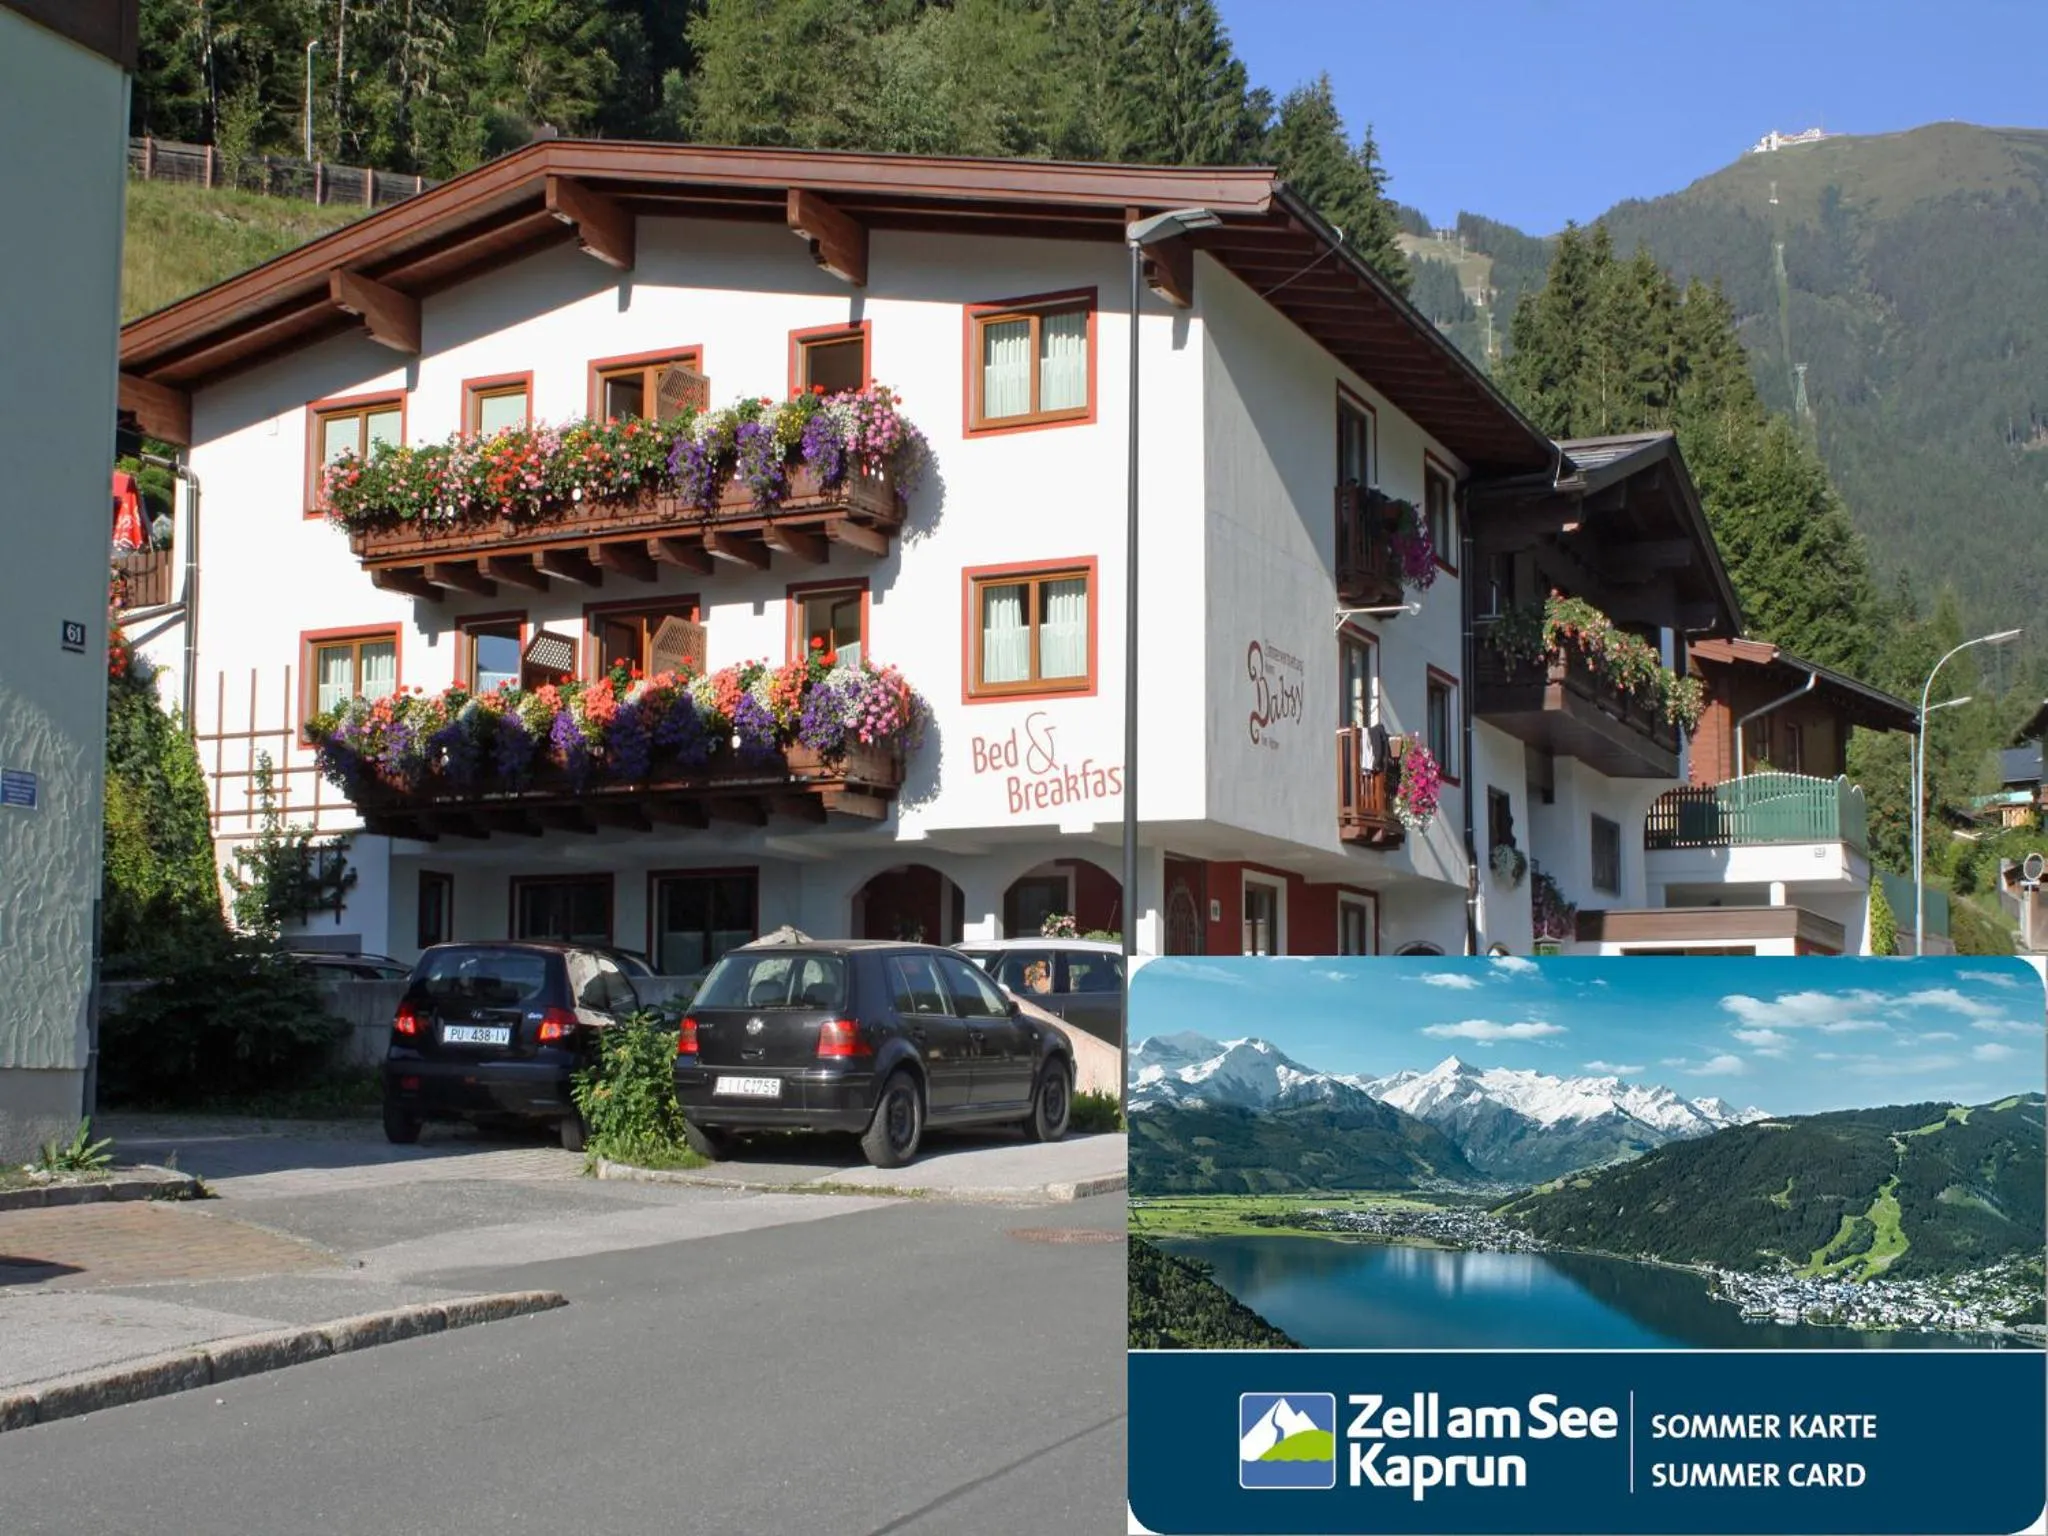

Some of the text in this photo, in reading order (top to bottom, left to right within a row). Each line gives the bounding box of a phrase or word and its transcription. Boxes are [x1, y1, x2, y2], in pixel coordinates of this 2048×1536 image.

[66, 623, 82, 643] 61
[971, 711, 1060, 776] Bed &
[1006, 758, 1126, 815] Breakfas
